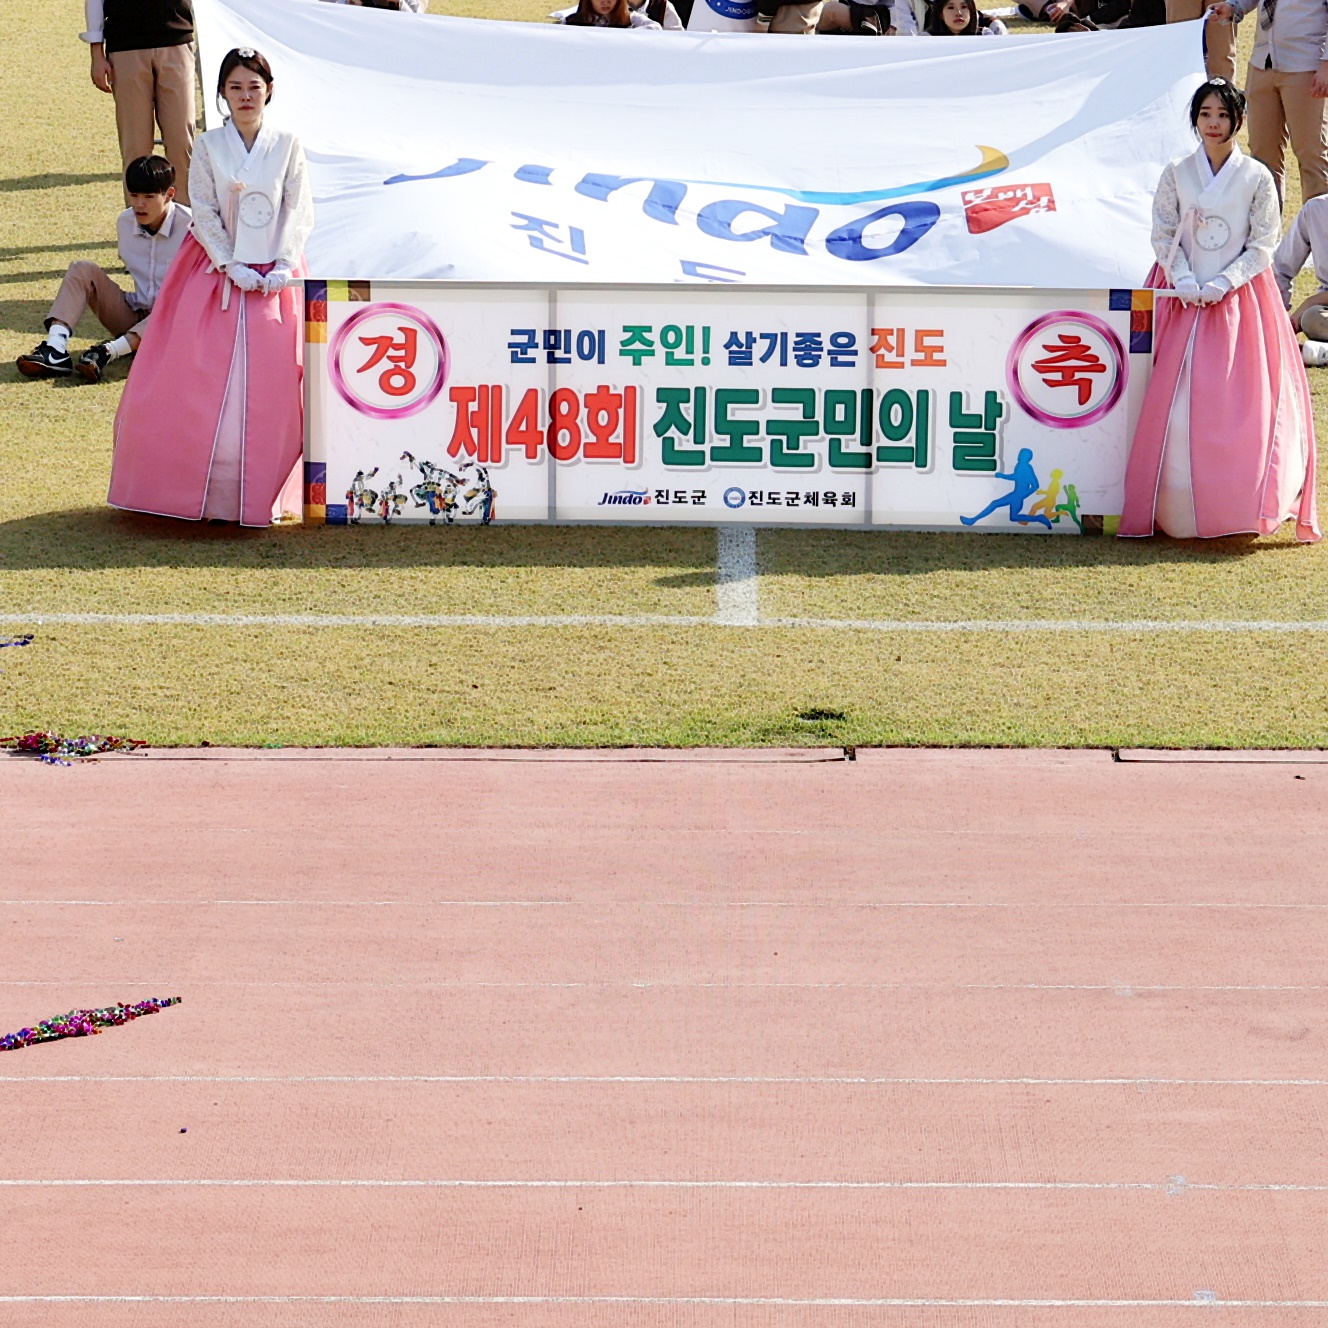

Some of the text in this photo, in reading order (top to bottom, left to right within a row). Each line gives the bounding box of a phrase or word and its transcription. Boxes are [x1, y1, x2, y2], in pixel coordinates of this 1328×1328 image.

[356, 326, 419, 398] 경
[507, 324, 948, 370] 군민이 주인! 살기좋은 진도
[1030, 333, 1107, 406] 축
[446, 383, 1003, 472] 제48회 진도군민의 날
[598, 492, 644, 507] Jindo
[654, 488, 708, 506] 진도군
[748, 490, 857, 509] 진도군체육회
